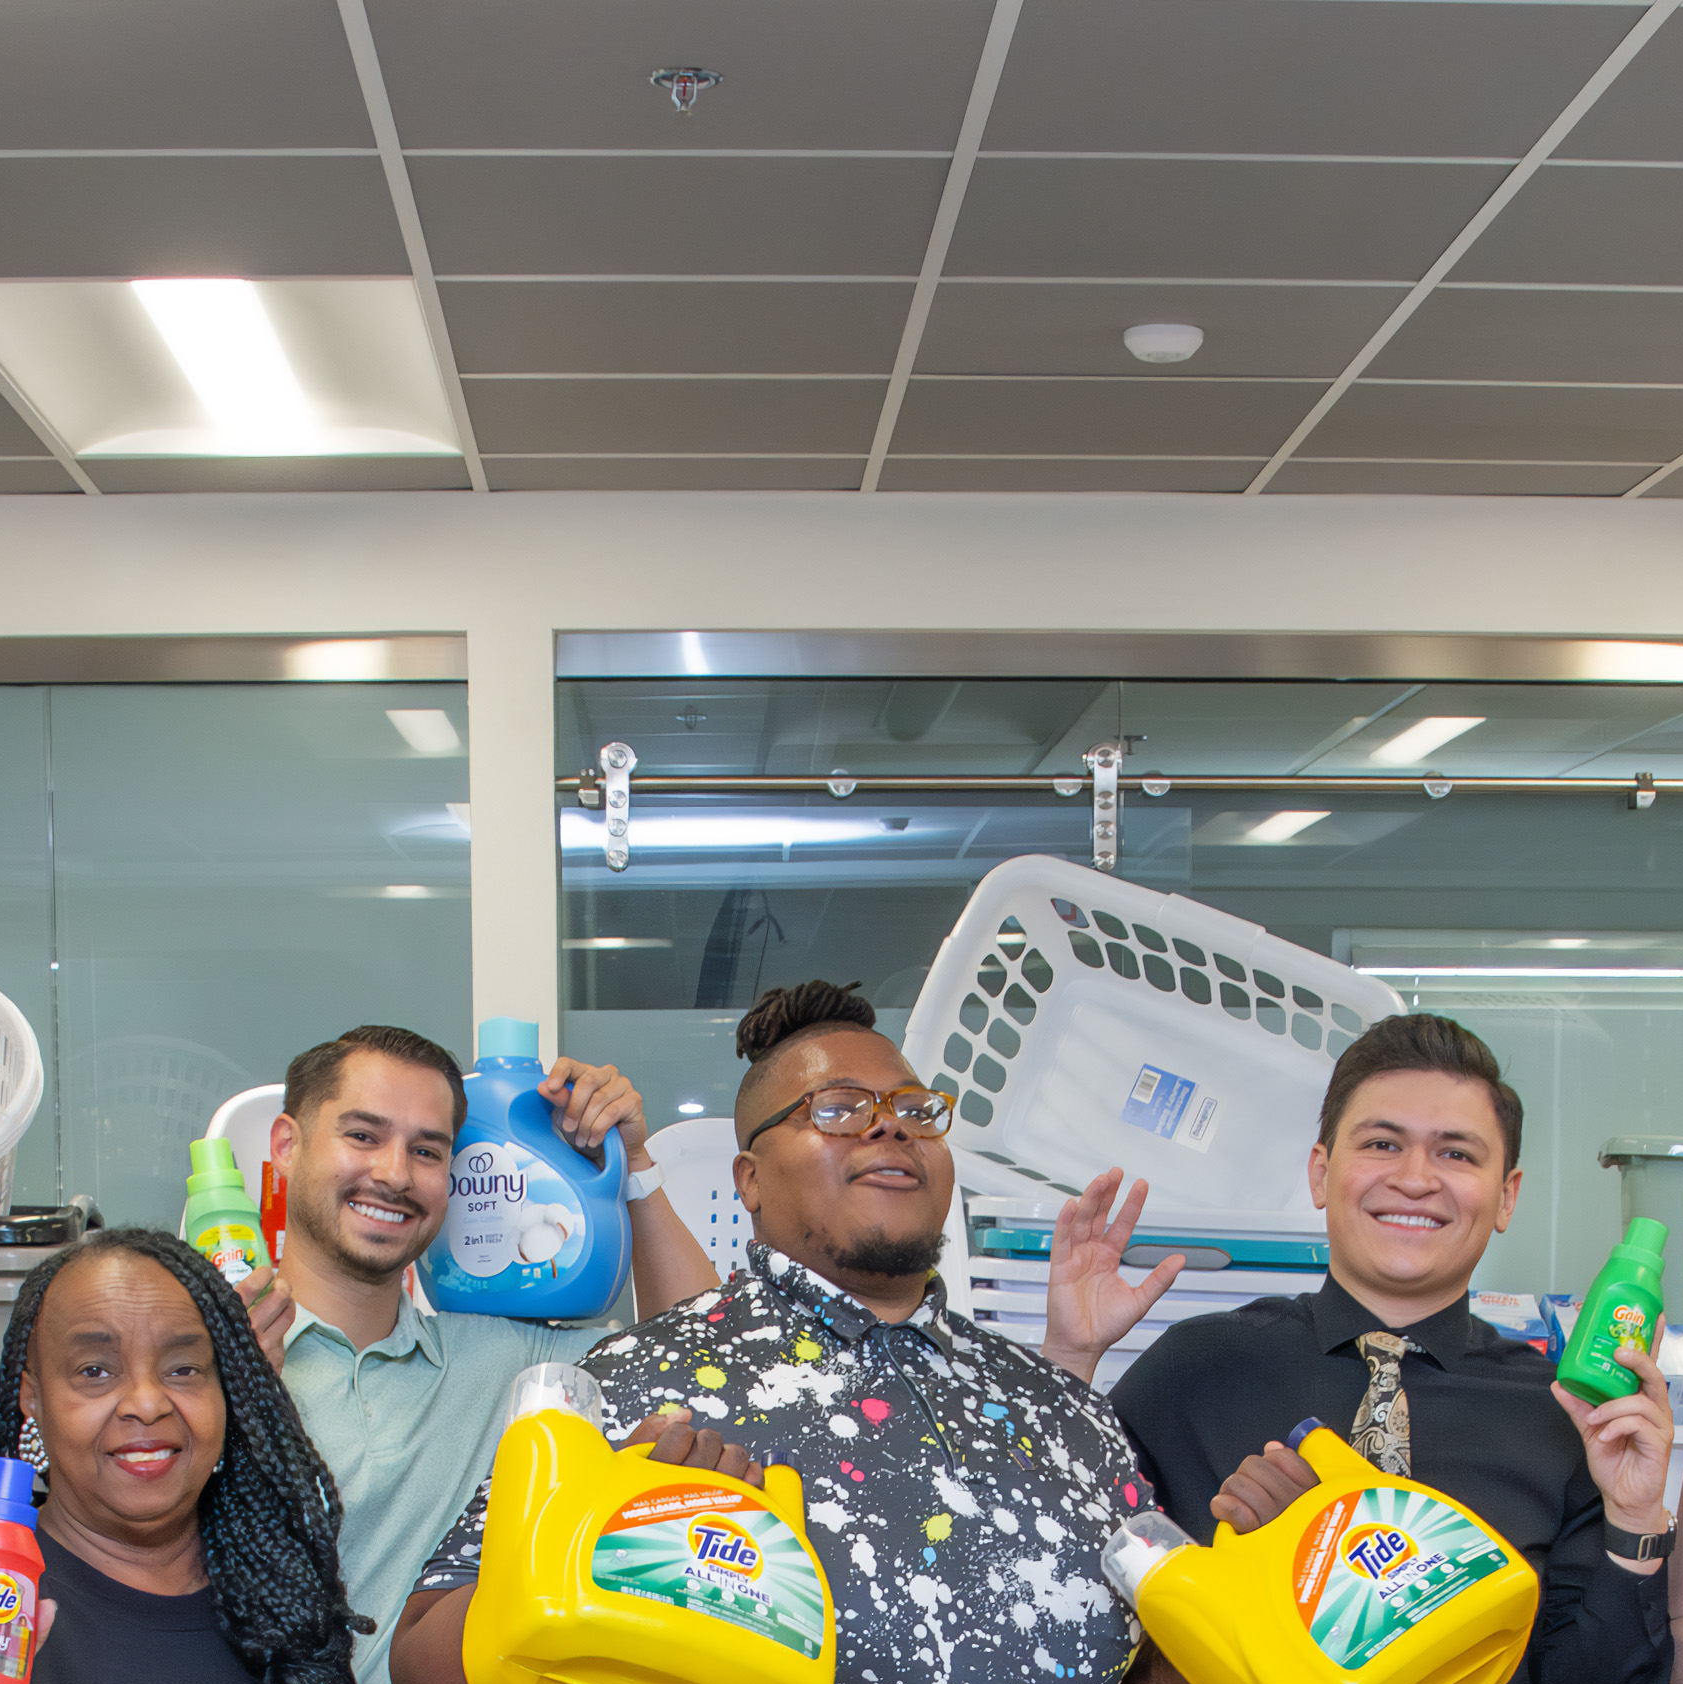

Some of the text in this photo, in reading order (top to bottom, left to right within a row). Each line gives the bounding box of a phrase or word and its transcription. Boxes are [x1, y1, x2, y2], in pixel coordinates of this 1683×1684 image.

[468, 1201, 496, 1212] SOFT
[1614, 1306, 1646, 1326] Gain
[694, 1526, 757, 1567] Tide
[1348, 1531, 1407, 1580] Tide
[709, 1564, 749, 1584] SIMPLY
[1378, 1554, 1445, 1600] ALL IN ONE
[1387, 1557, 1419, 1580] SIMPLY
[684, 1565, 771, 1604] ALL IN ONE
